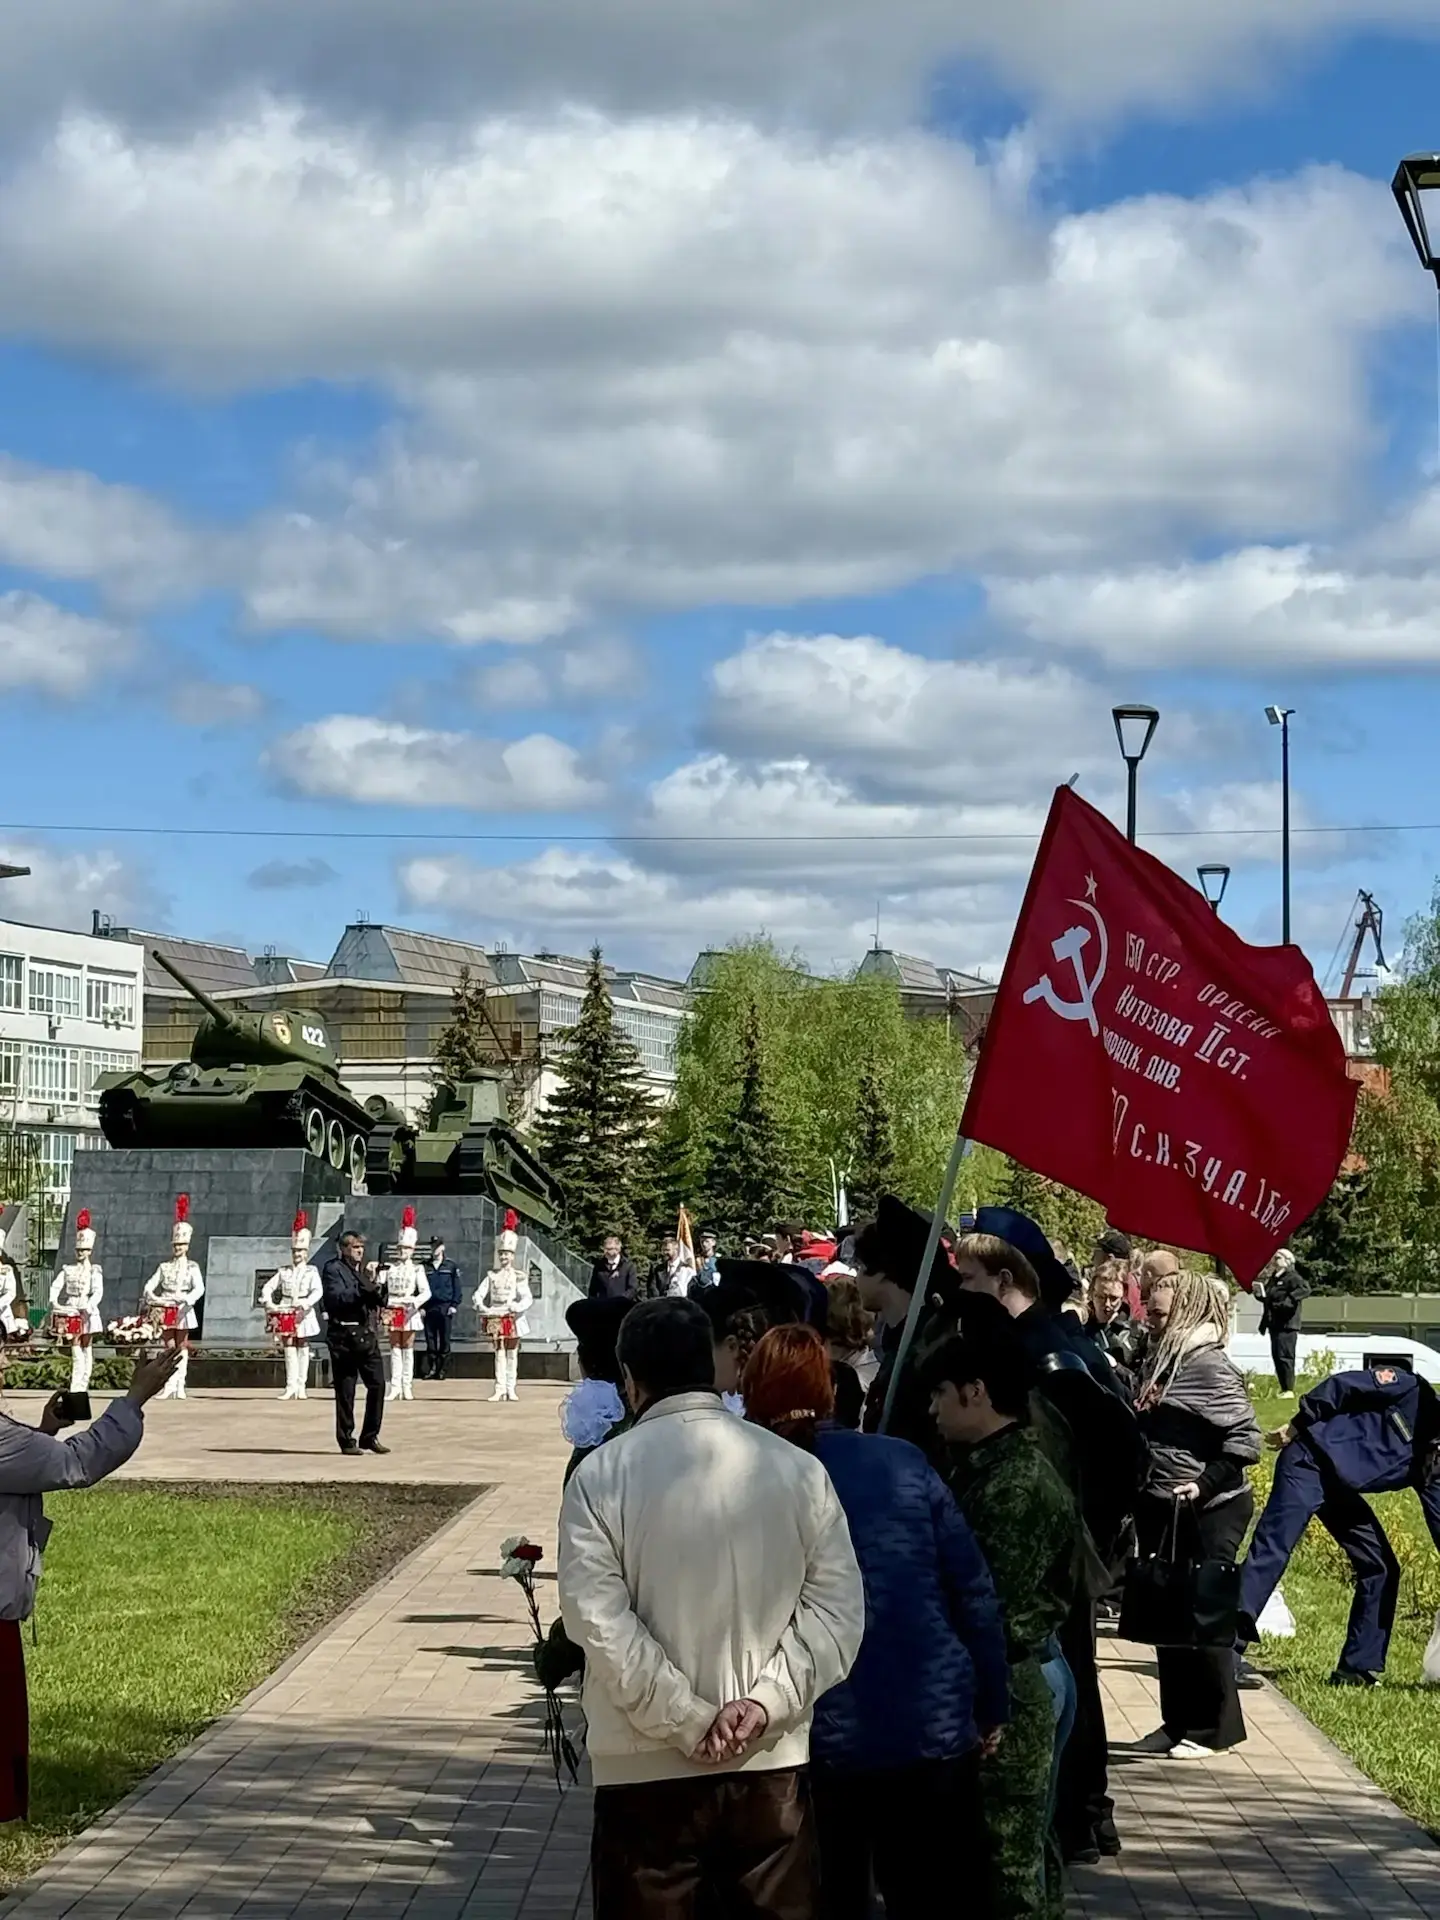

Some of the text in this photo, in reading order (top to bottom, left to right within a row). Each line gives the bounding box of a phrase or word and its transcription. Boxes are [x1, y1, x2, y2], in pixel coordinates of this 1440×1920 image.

[1125, 931, 1145, 973] 150
[1197, 983, 1282, 1038] ОРДЕНА
[302, 1025, 326, 1048] 422
[1143, 1055, 1181, 1093] ДИВ.
